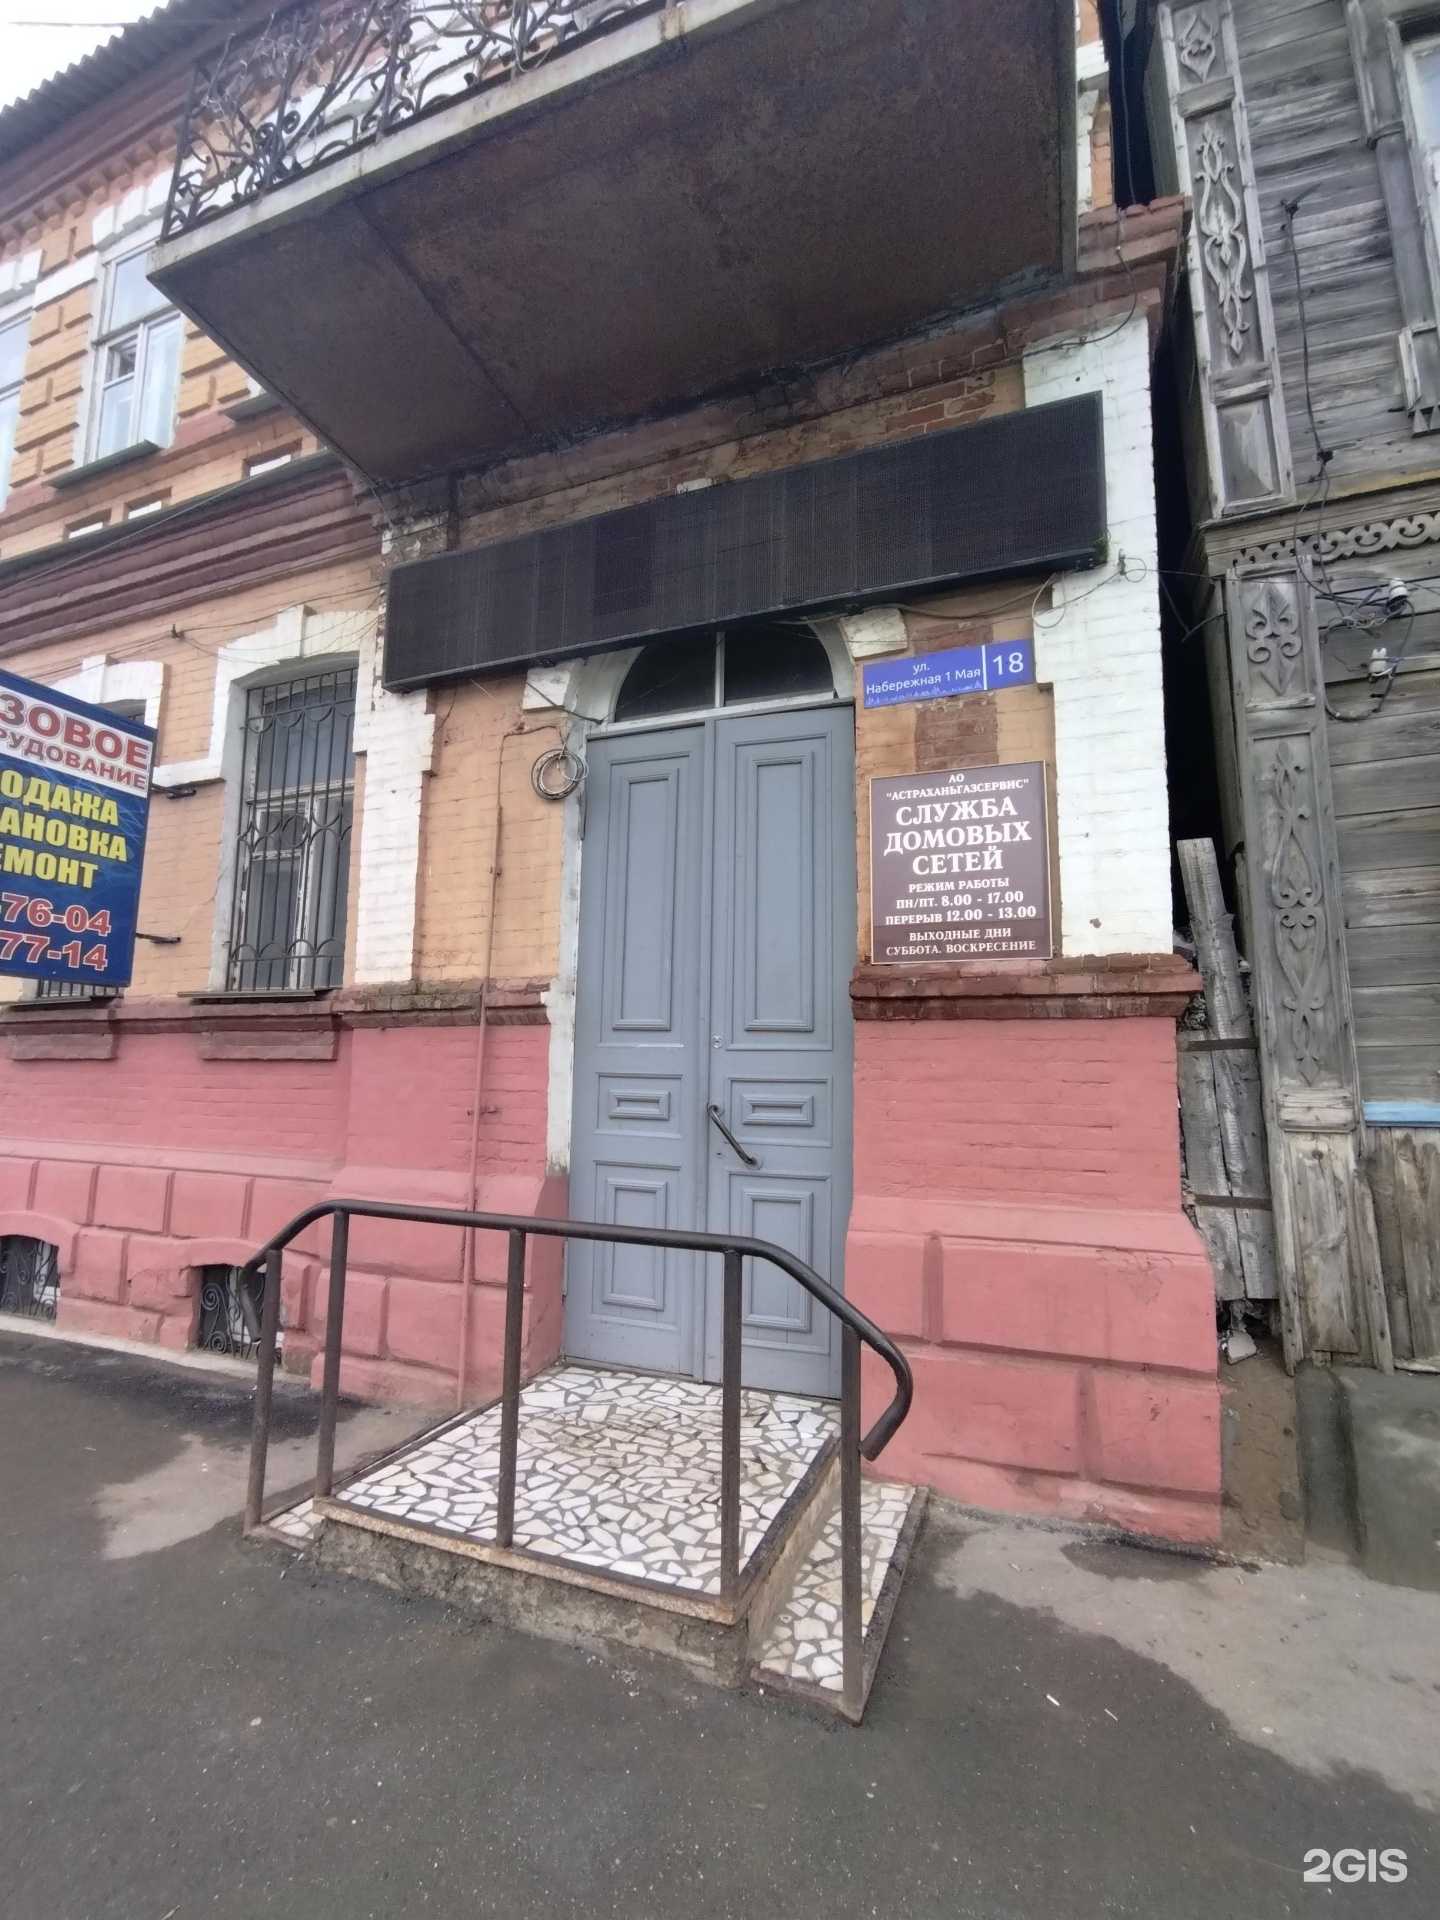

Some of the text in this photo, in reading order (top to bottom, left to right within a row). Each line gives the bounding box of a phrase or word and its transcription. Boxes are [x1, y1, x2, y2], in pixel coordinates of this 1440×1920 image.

[912, 662, 930, 676] ул.
[992, 651, 1024, 676] 18
[866, 667, 981, 694] Набережная 1 Мая
[949, 773, 965, 783] АО
[1, 769, 119, 826] ОДАЖА
[886, 779, 1030, 800] "АСТРАХАНЬГАЗСЕРВИС"
[895, 796, 1018, 826] СЛУЖБА
[883, 821, 1033, 856] ДОМОВЫХ
[912, 846, 1004, 875] СЕТЕЙ
[908, 878, 1009, 893] РЕЖИМ РАБОТЫ
[896, 898, 938, 909] ПН/ПТ.
[941, 894, 972, 906] 8.00
[987, 891, 1024, 904] 17.00
[0, 892, 112, 937] 76-04
[885, 913, 943, 925] ПЕРЕРЫВ
[946, 909, 982, 922] 12.00
[998, 905, 1037, 919] 13.00
[909, 927, 1012, 941] ВЫХОДНЫЕ ДНИ
[946, 940, 1036, 953] ВОСКРЕСЕНИЕ
